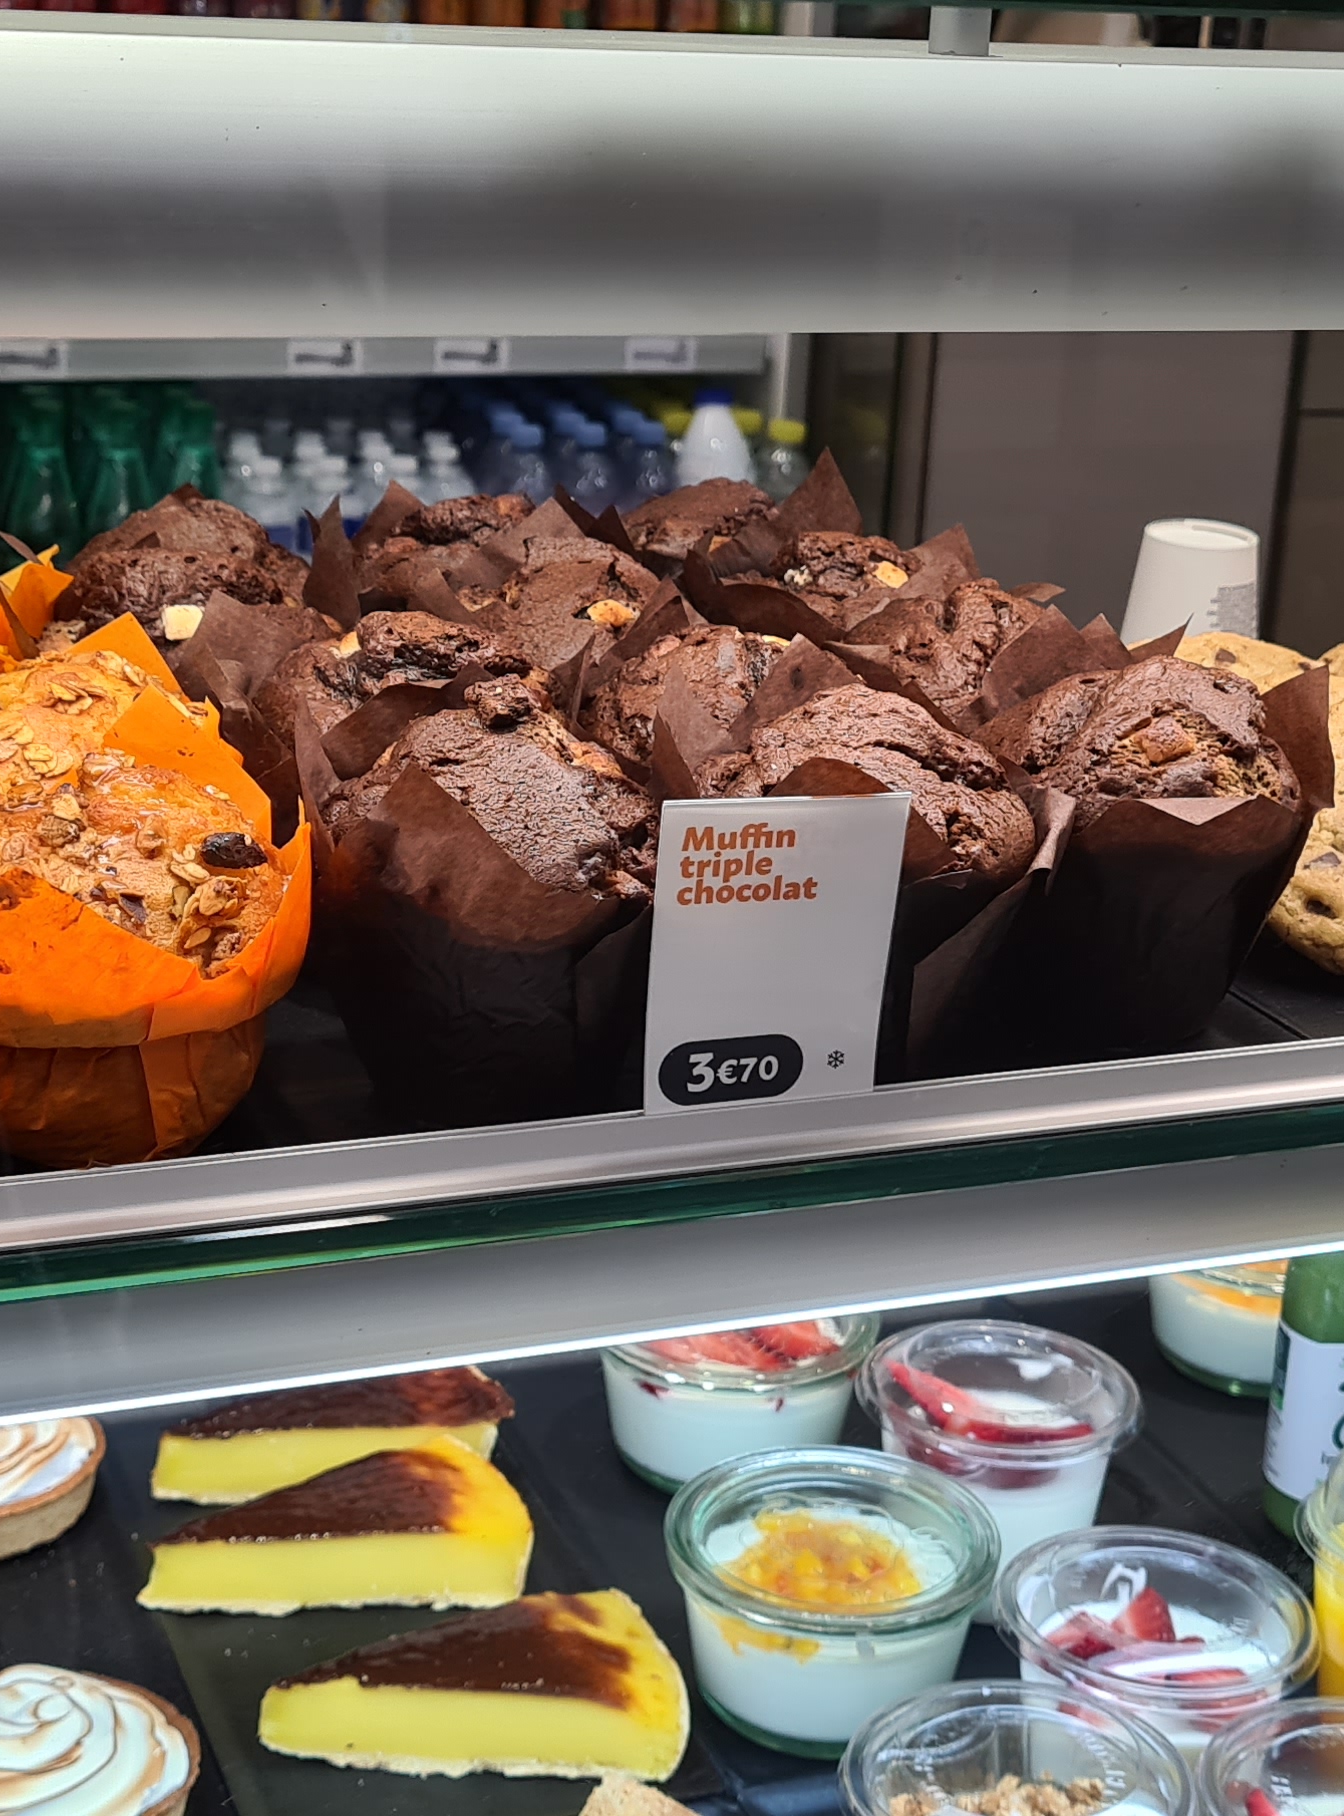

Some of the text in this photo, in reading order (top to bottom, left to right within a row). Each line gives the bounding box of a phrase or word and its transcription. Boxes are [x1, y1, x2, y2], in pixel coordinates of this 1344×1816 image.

[681, 822, 796, 851] Muffin
[679, 851, 773, 883] triple
[676, 875, 818, 906] chocolat
[686, 1052, 779, 1093] 3€70
